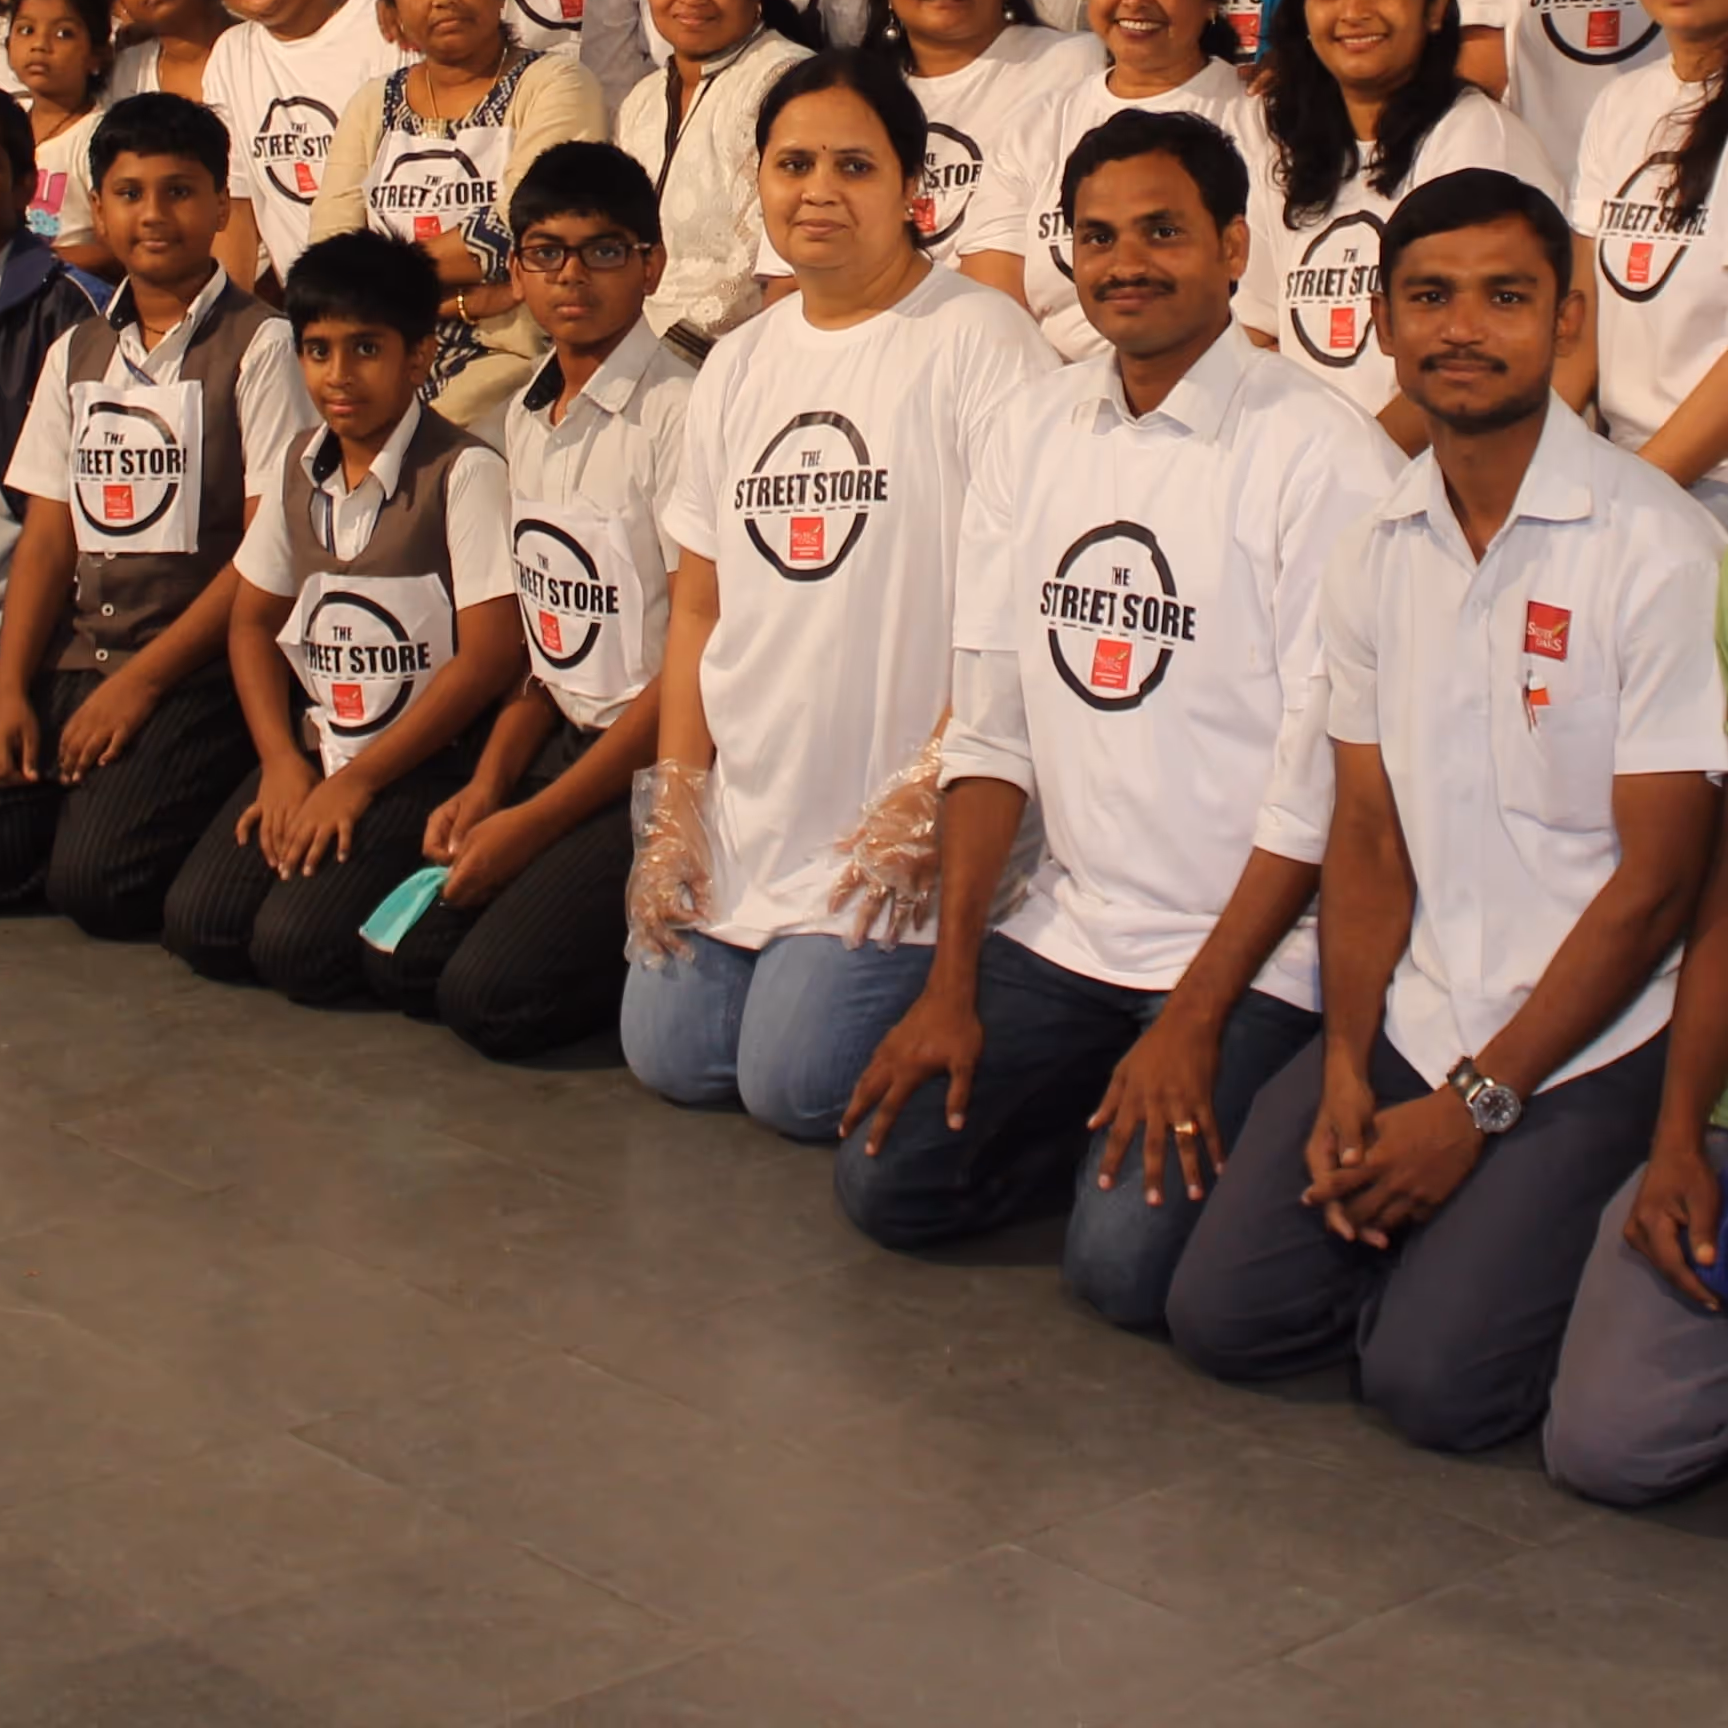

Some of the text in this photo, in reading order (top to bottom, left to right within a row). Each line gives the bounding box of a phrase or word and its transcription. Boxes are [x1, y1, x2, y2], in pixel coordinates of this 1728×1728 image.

[370, 180, 498, 210] STREET STORE
[102, 431, 126, 445] THE
[801, 450, 822, 468] THE
[734, 469, 889, 511] STREET STORE
[547, 578, 620, 615] STORE
[1039, 580, 1118, 628] STREET
[332, 626, 353, 642] THE
[349, 642, 431, 674] STORE
